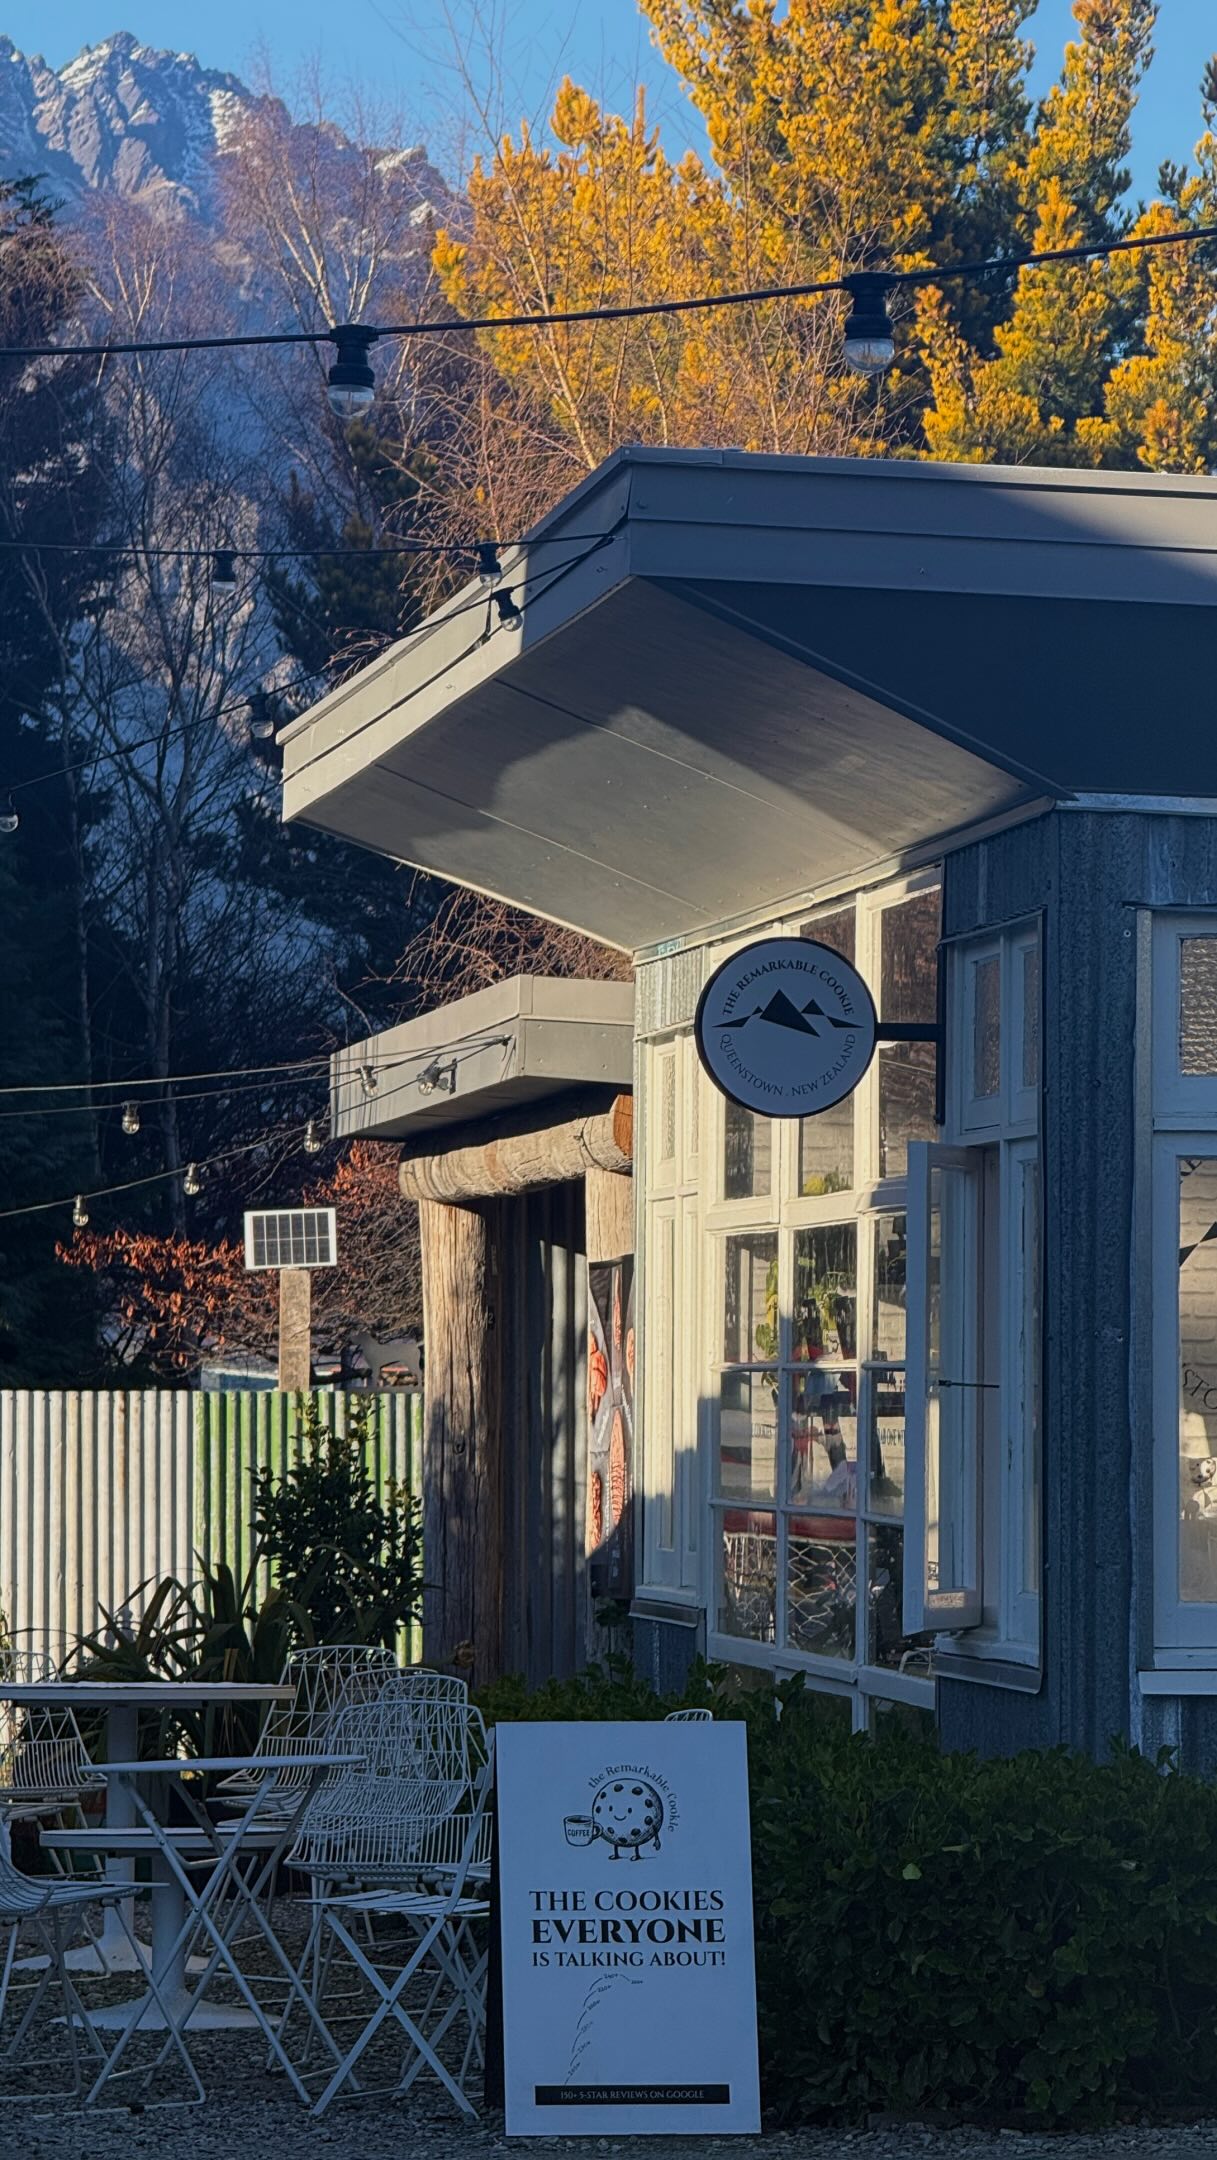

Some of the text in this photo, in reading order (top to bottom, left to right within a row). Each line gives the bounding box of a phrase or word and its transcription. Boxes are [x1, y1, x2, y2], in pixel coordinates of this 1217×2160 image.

[723, 959, 855, 1016] THE REMARKABLE COOKIE
[720, 1033, 784, 1096] QUEENSTOWN
[791, 1080, 819, 1097] NEW
[819, 1034, 856, 1086] ZEALAND
[588, 1764, 681, 1833] the Remarkable Cookie
[567, 1829, 590, 1838] COFFEE
[529, 1890, 725, 1912] THE COOKIES
[531, 1918, 726, 1944] EVERYONE
[533, 1950, 726, 1967] IS TALKING ABOUT!
[579, 2090, 608, 2099] 5-STAR
[610, 2090, 649, 2099] REVIEWS
[650, 2090, 665, 2098] ON
[666, 2089, 705, 2099] GOOGLE
